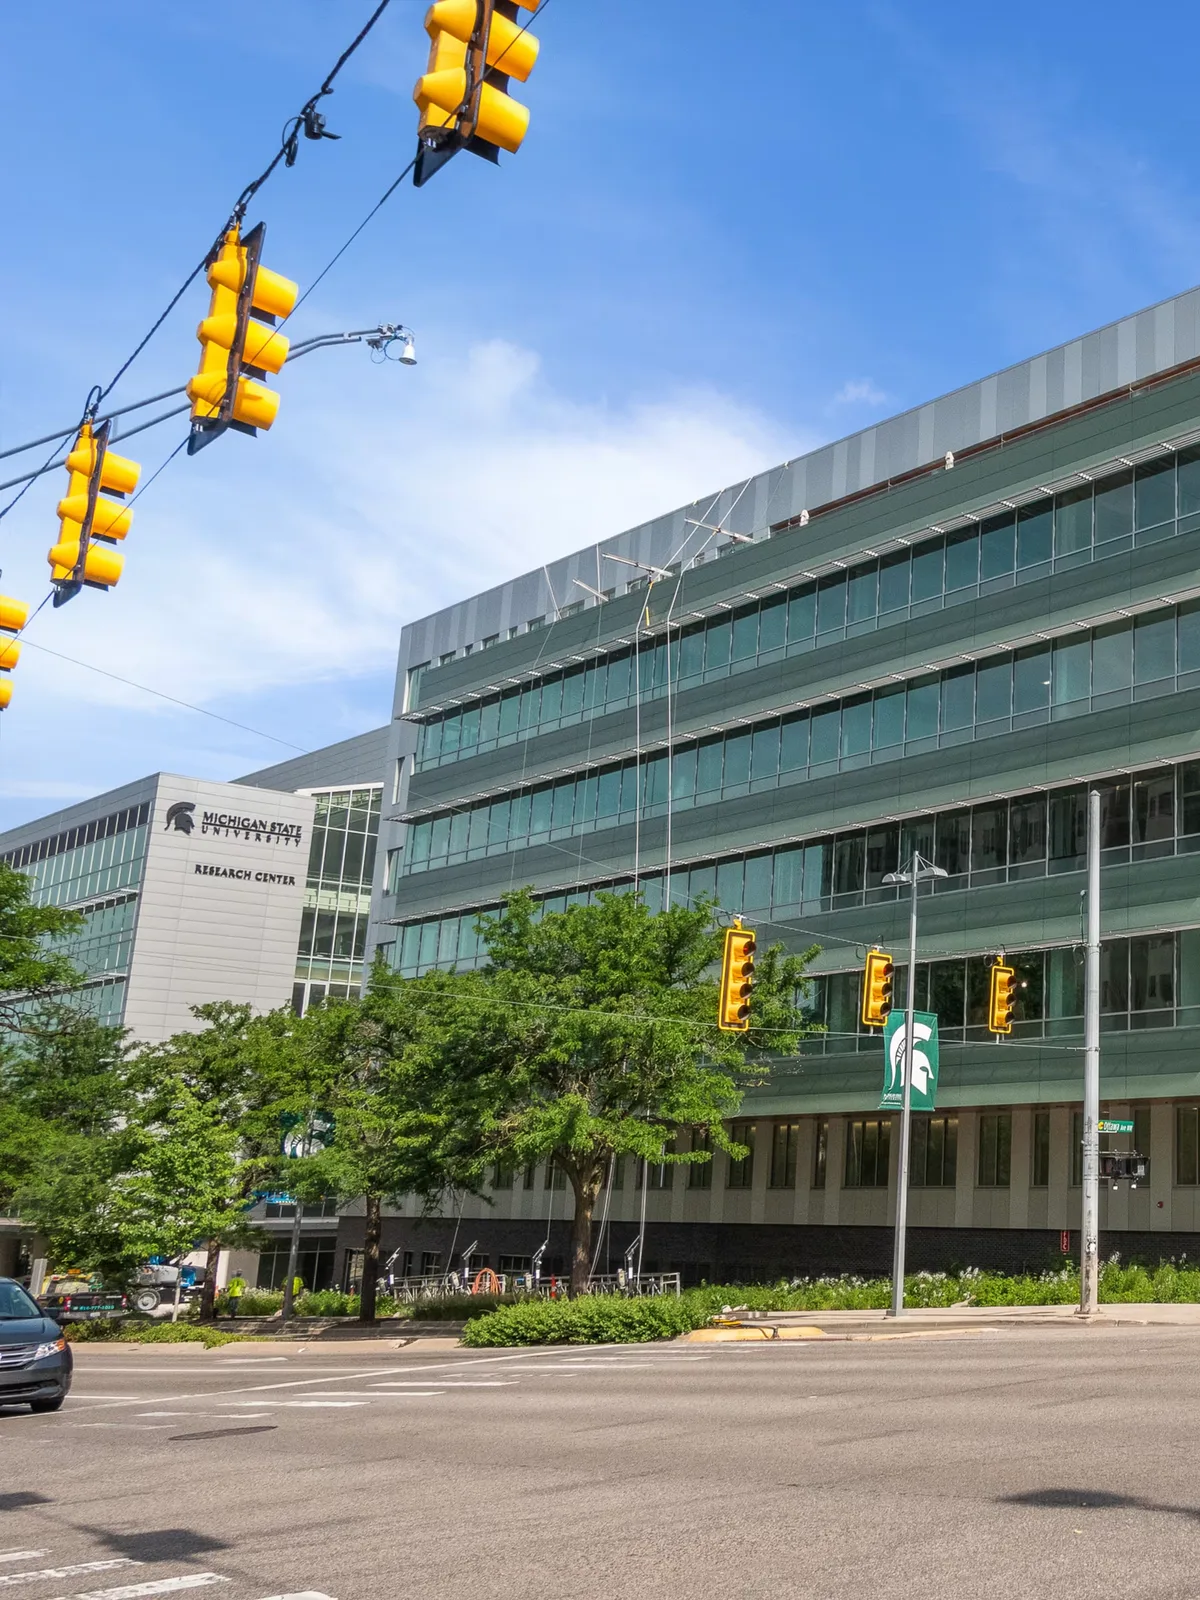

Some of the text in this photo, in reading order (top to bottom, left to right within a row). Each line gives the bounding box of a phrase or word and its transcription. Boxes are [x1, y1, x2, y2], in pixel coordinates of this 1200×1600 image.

[203, 811, 302, 836] MICHIGAN STATE
[201, 825, 301, 847] UNIVERSITY
[195, 864, 296, 886] RESEARCH CENTER
[1103, 1121, 1120, 1131] Ottawa
